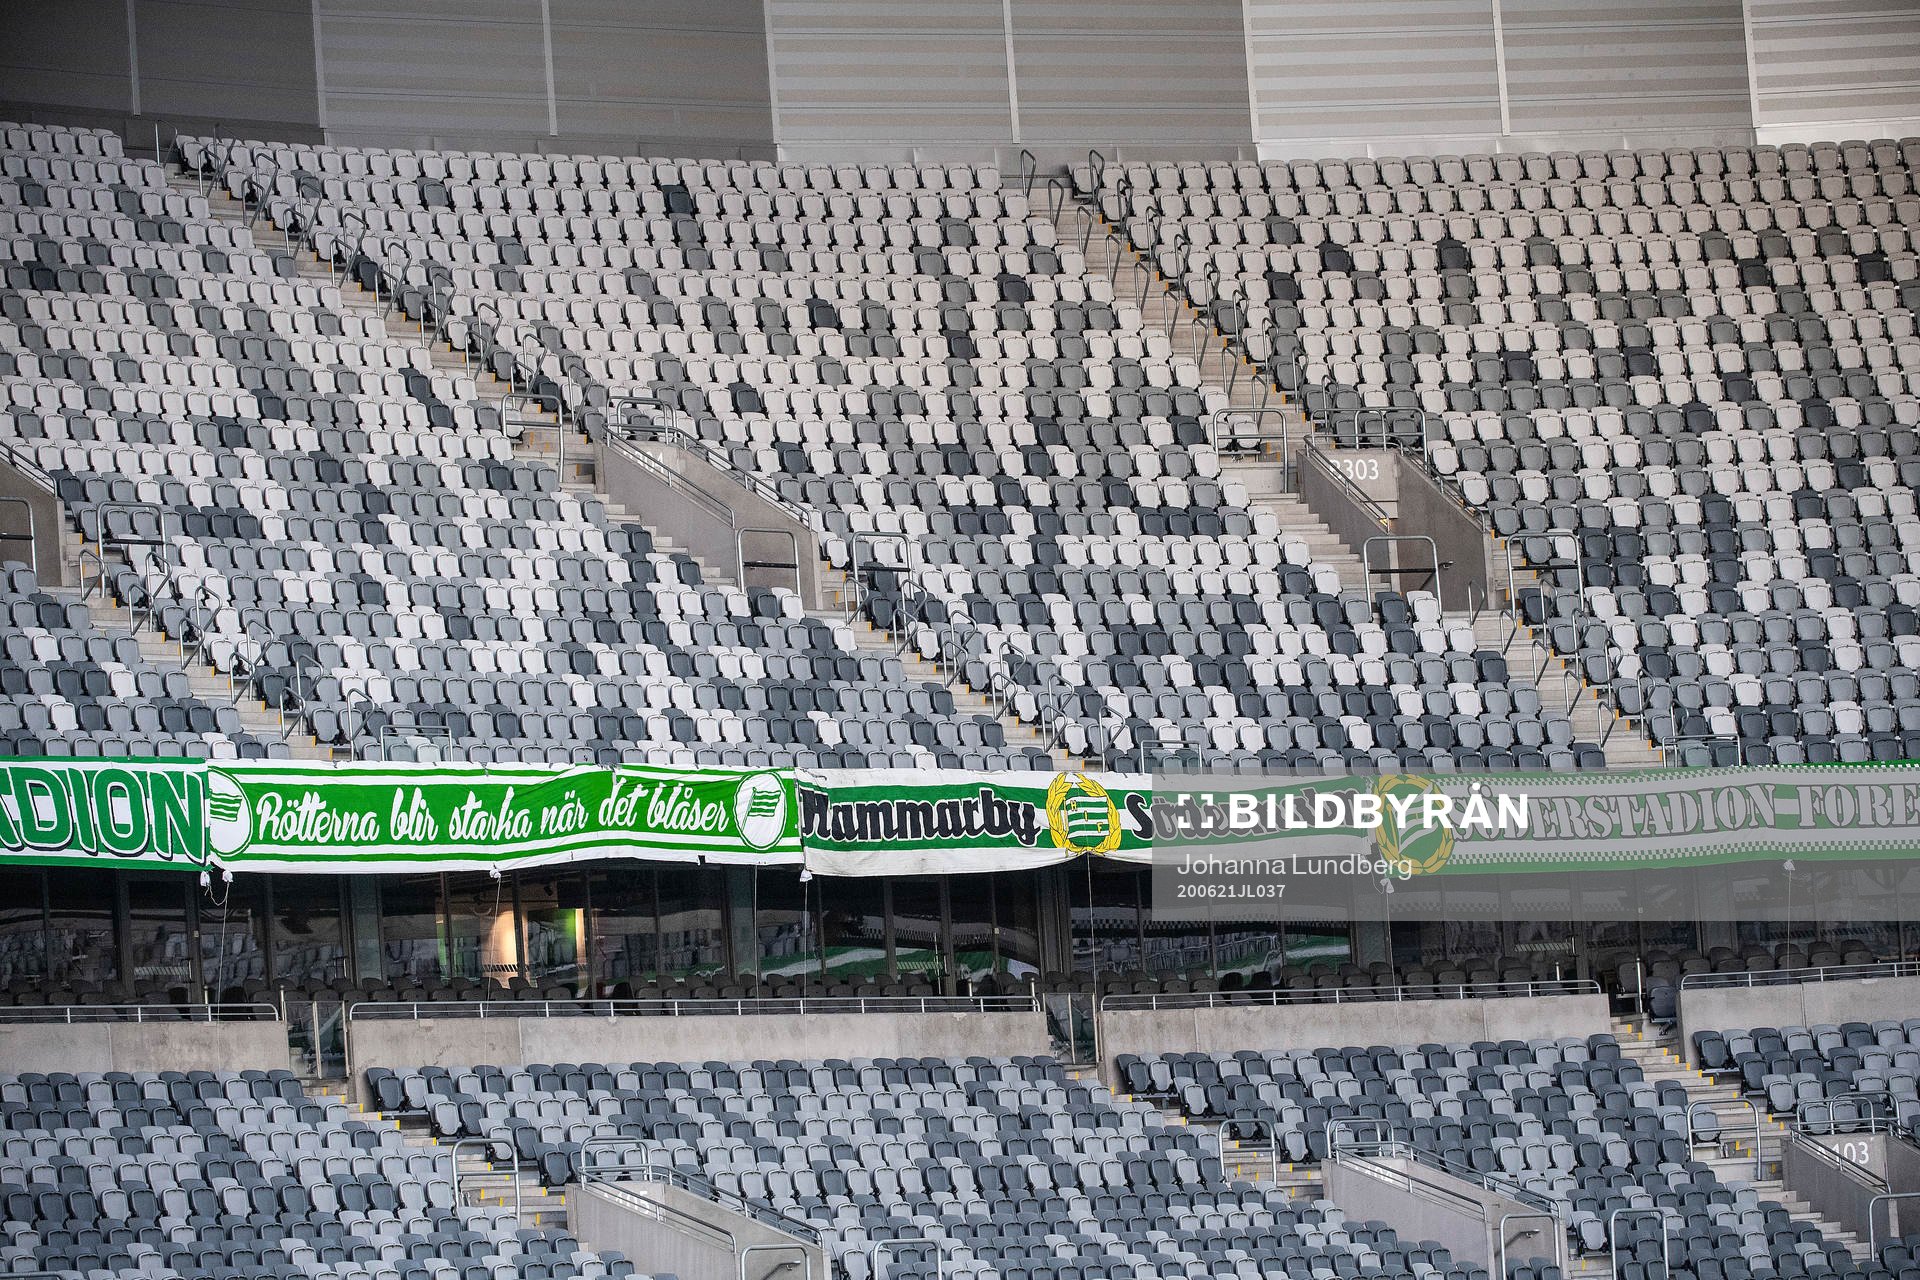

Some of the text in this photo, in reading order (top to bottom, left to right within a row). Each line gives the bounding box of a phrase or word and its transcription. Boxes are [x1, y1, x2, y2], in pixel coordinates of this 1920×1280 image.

[256, 777, 729, 843] Rötterna blir starka när det blåser
[800, 787, 1041, 847] Hammarby
[1817, 1141, 1869, 1165] 103
